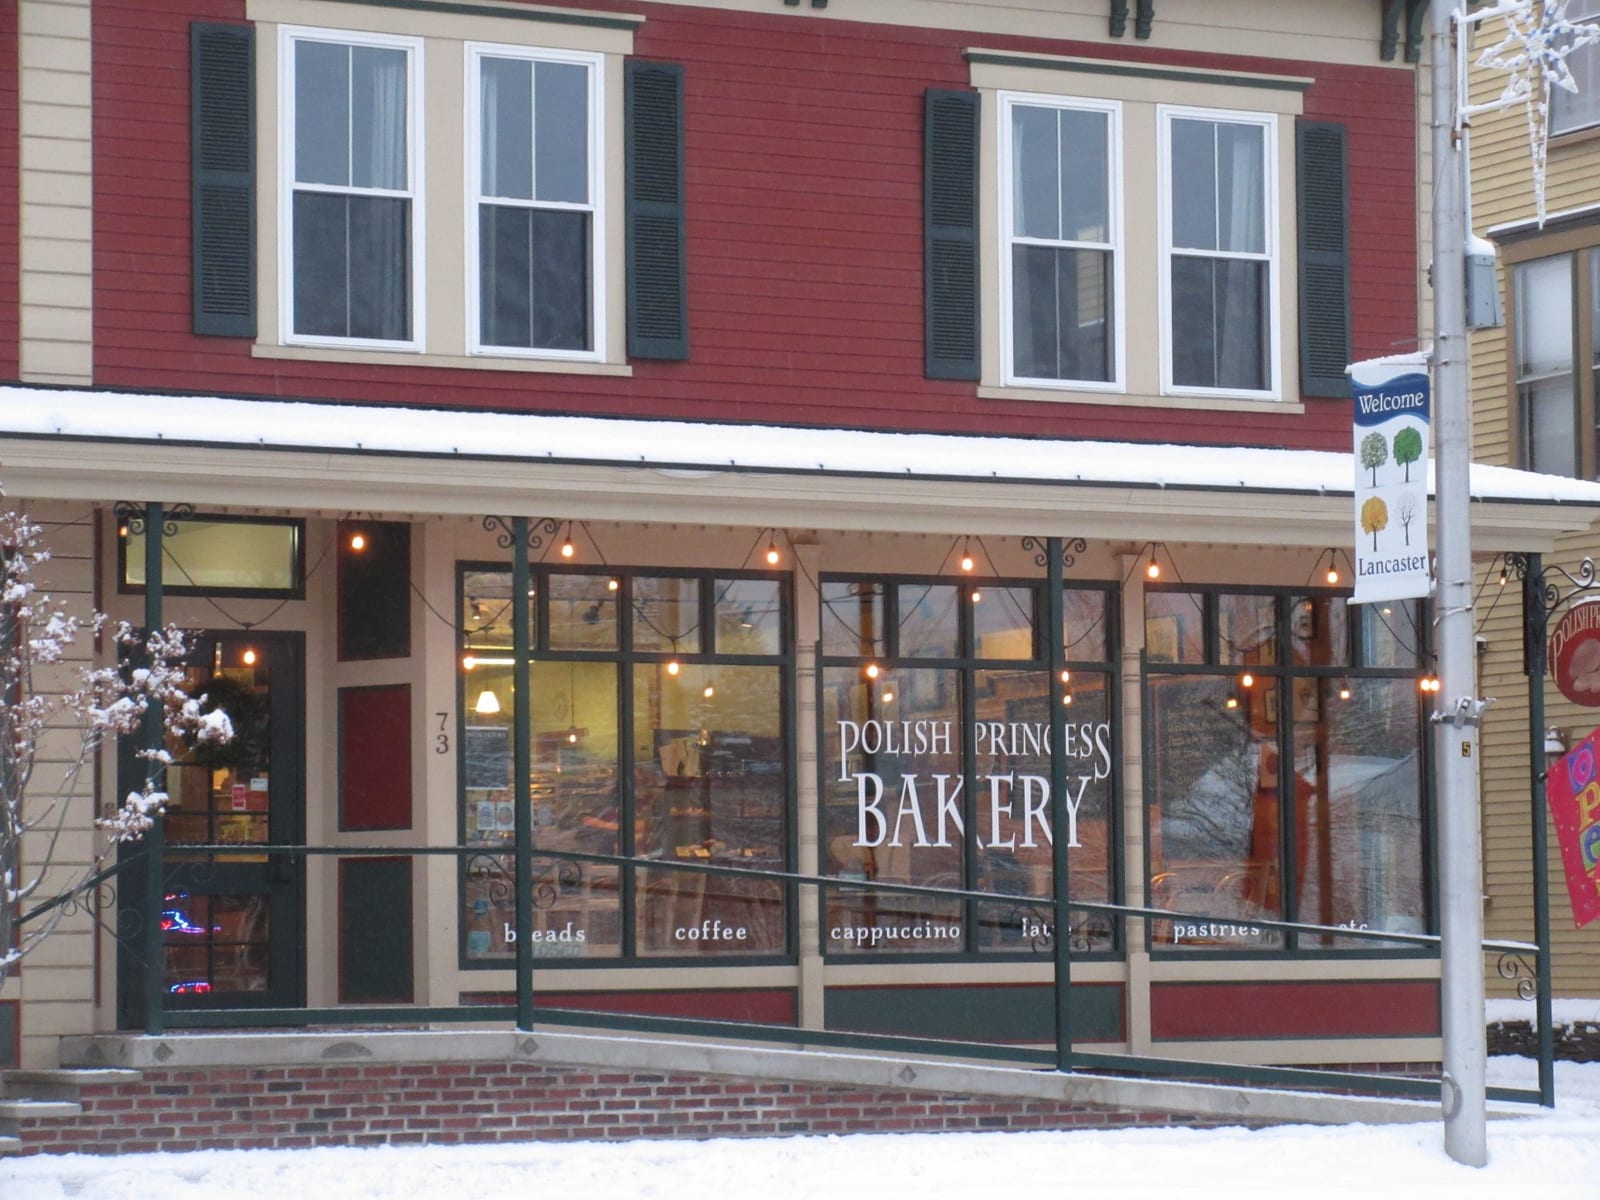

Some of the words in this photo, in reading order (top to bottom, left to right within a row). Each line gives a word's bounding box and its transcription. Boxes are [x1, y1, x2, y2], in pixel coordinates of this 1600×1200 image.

[1358, 392, 1424, 414] Welcome
[1358, 555, 1426, 577] Lancaster
[1553, 605, 1589, 685] POLISH
[435, 712, 449, 754] 73
[837, 719, 953, 782] POLISH
[1463, 742, 1470, 756] 5
[852, 772, 1092, 853] BAKERY
[504, 922, 586, 943] beads
[675, 919, 747, 941] coffee
[830, 921, 960, 946] cappuccino
[1022, 917, 1073, 937] lat
[1173, 923, 1260, 944] pastries
